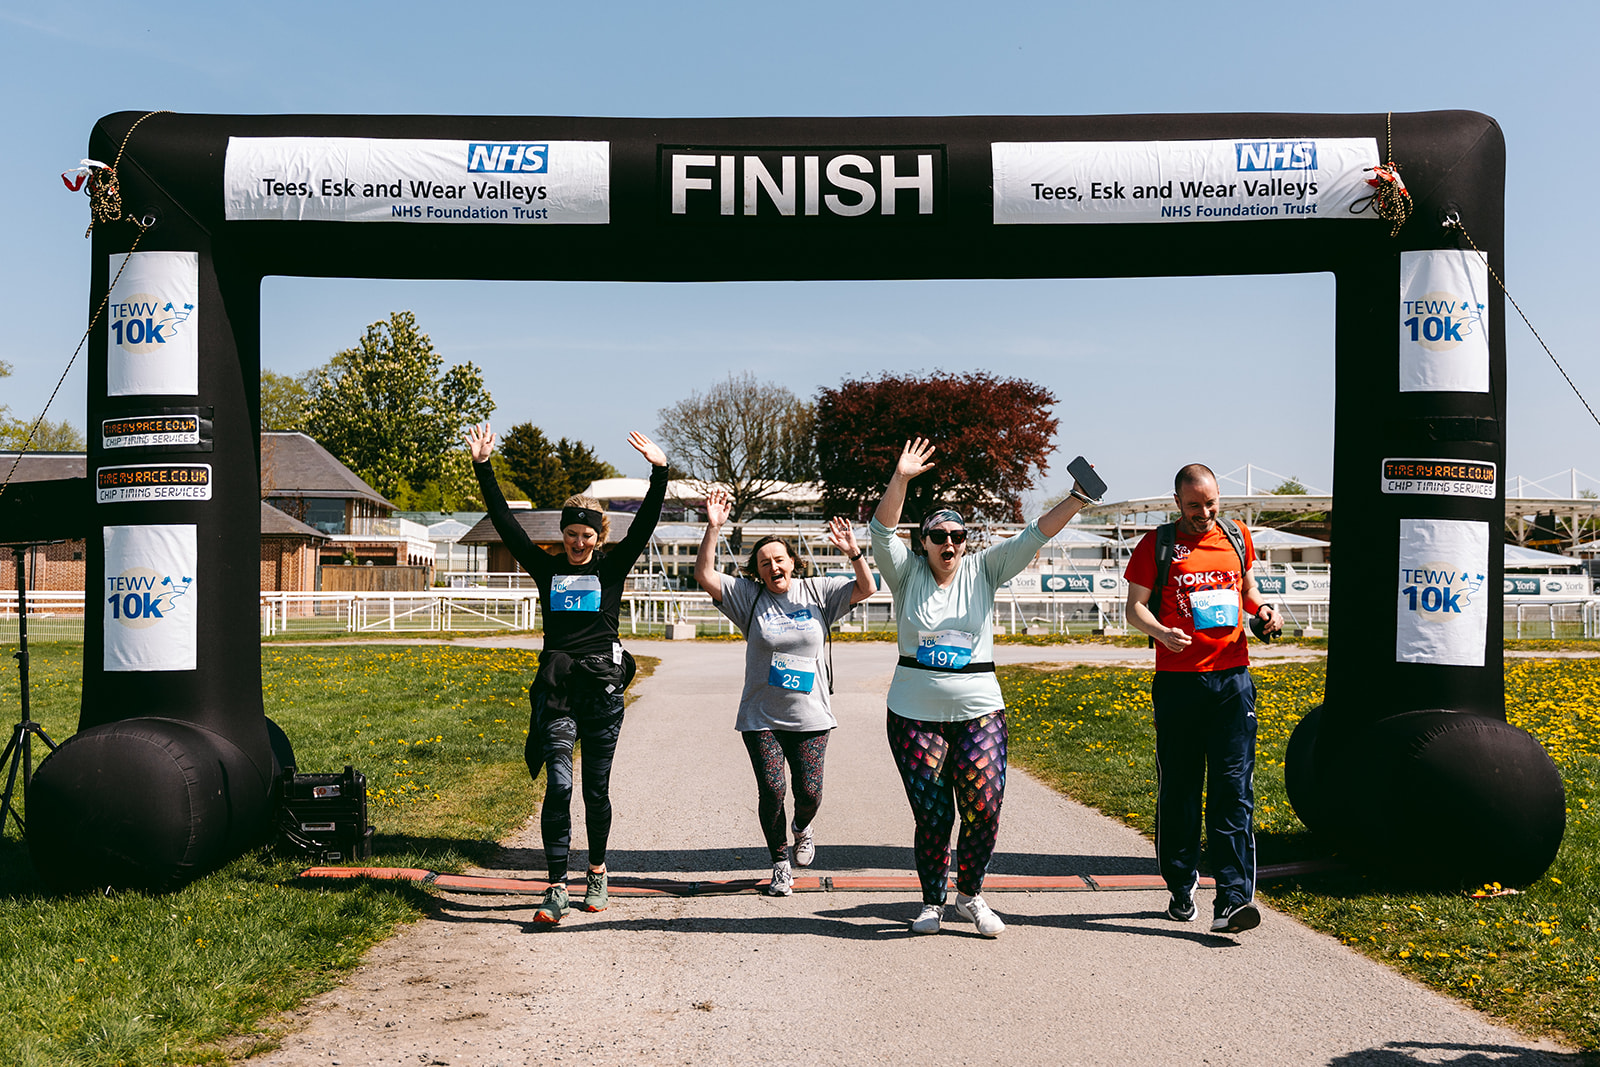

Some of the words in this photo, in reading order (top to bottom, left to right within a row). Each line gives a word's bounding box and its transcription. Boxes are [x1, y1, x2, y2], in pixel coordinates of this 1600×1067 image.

[468, 144, 546, 172] NHS
[1238, 142, 1315, 170] NHS
[262, 178, 314, 199] Tees,
[321, 178, 356, 198] Esk
[363, 178, 402, 198] and
[410, 180, 467, 200] Wear
[473, 181, 548, 205] Valleys
[671, 154, 934, 217] FINISH
[1031, 182, 1084, 202] Tees,
[1090, 181, 1125, 200] Esk
[1133, 180, 1173, 200] and
[1179, 180, 1237, 199] Wear
[1243, 178, 1319, 202] Valleys
[391, 205, 422, 218] NHS
[426, 206, 508, 219] Foundation
[512, 207, 548, 219] Trust
[1160, 205, 1192, 218] NHS
[1196, 203, 1279, 217] Foundation
[1283, 202, 1318, 216] Trust
[110, 302, 158, 318] TEWV
[1403, 301, 1456, 315] TEWV
[111, 318, 166, 345] 10k
[1404, 316, 1463, 342] 10k
[105, 438, 122, 447] CHIP
[124, 435, 149, 445] TIMING
[152, 433, 196, 444] SERVICES
[100, 490, 118, 501] CHIP
[120, 487, 151, 499] TIMING
[154, 486, 207, 498] SERVICES
[1388, 481, 1413, 491] CHIP
[1416, 481, 1450, 493] TIMING
[1453, 482, 1493, 496] SERVICES
[107, 576, 156, 591] TEWV
[1015, 577, 1037, 586] York
[1067, 577, 1090, 588] York
[1173, 571, 1217, 587] YORK
[1260, 578, 1282, 589] York
[1402, 569, 1456, 585] TEWV
[1514, 580, 1537, 590] York
[108, 592, 164, 619] 10k
[563, 595, 582, 609] 51
[1402, 585, 1462, 613] 10k
[928, 650, 959, 667] 197
[782, 674, 801, 689] 25
